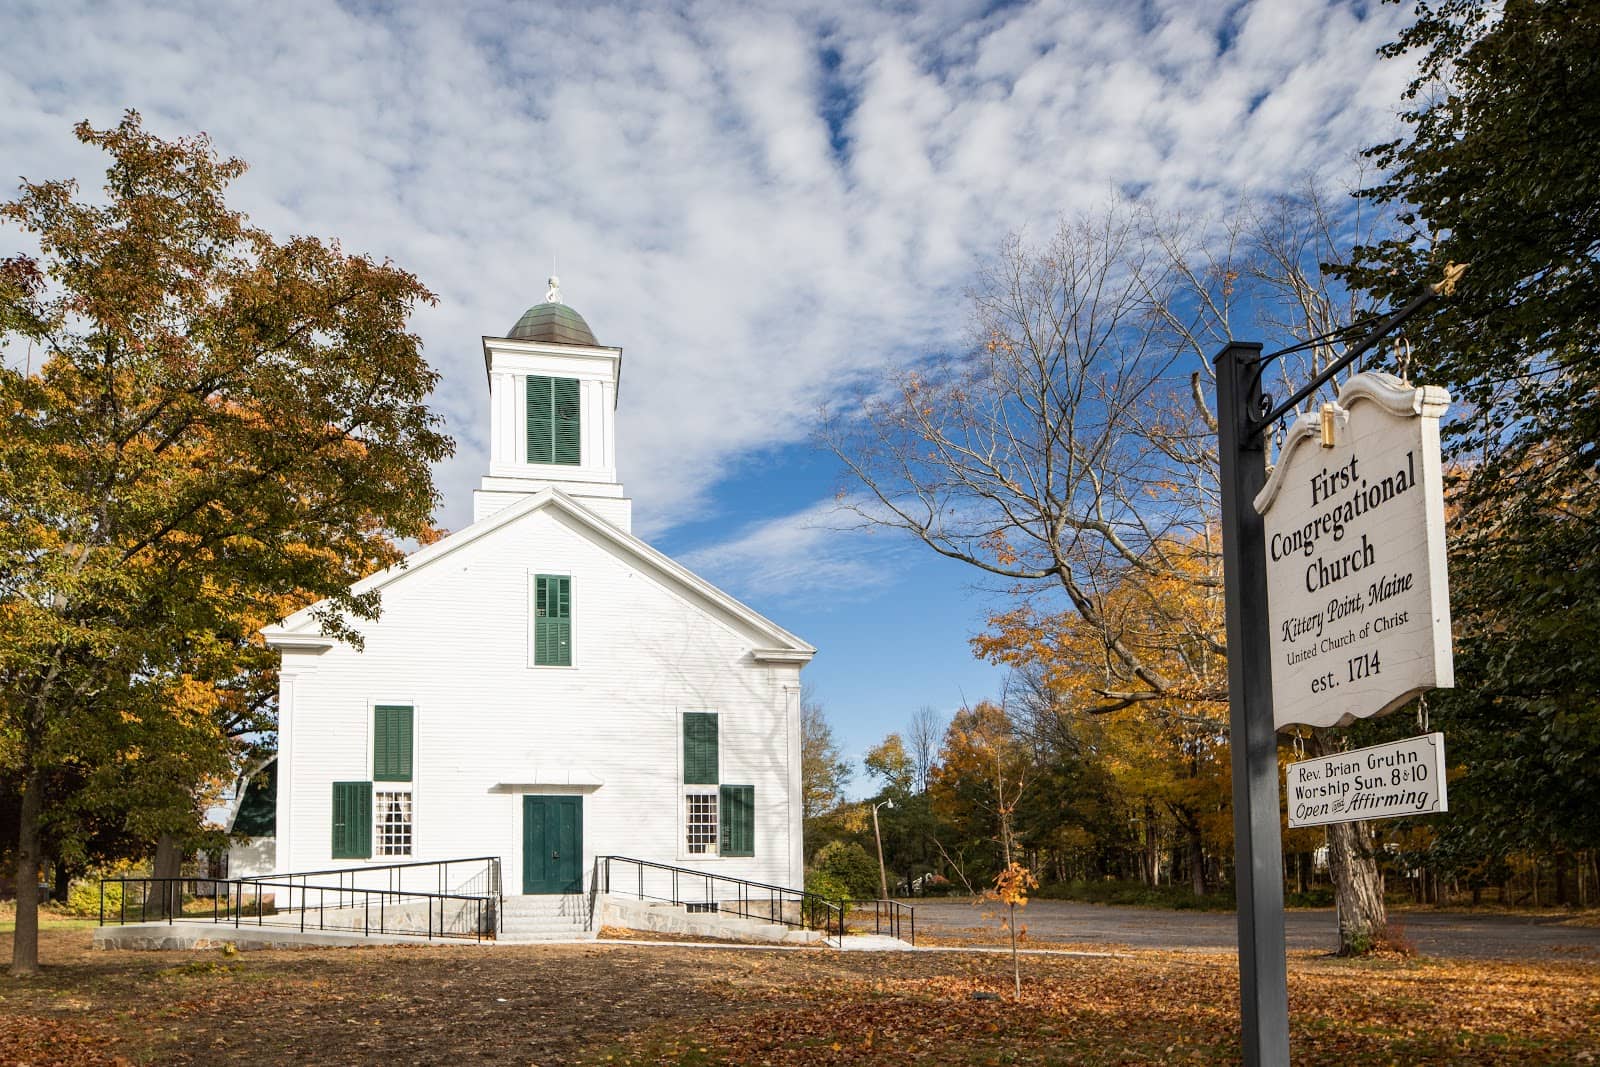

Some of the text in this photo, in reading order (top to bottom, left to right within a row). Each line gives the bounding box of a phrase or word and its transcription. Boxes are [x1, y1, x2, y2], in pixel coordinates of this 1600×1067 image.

[1271, 452, 1416, 562] Congregational
[1310, 453, 1360, 508] First
[1306, 534, 1376, 593] Church
[1282, 573, 1413, 642] Kittery Point, Maine
[1287, 611, 1409, 666] United Church of Christ
[1311, 650, 1381, 693] est. 1714
[1295, 780, 1350, 800] Worship
[1354, 775, 1387, 791] Sun.
[1299, 750, 1418, 783] Rev. Brian Gruhn
[1296, 802, 1329, 820] Open
[1345, 789, 1429, 813] Affirming
